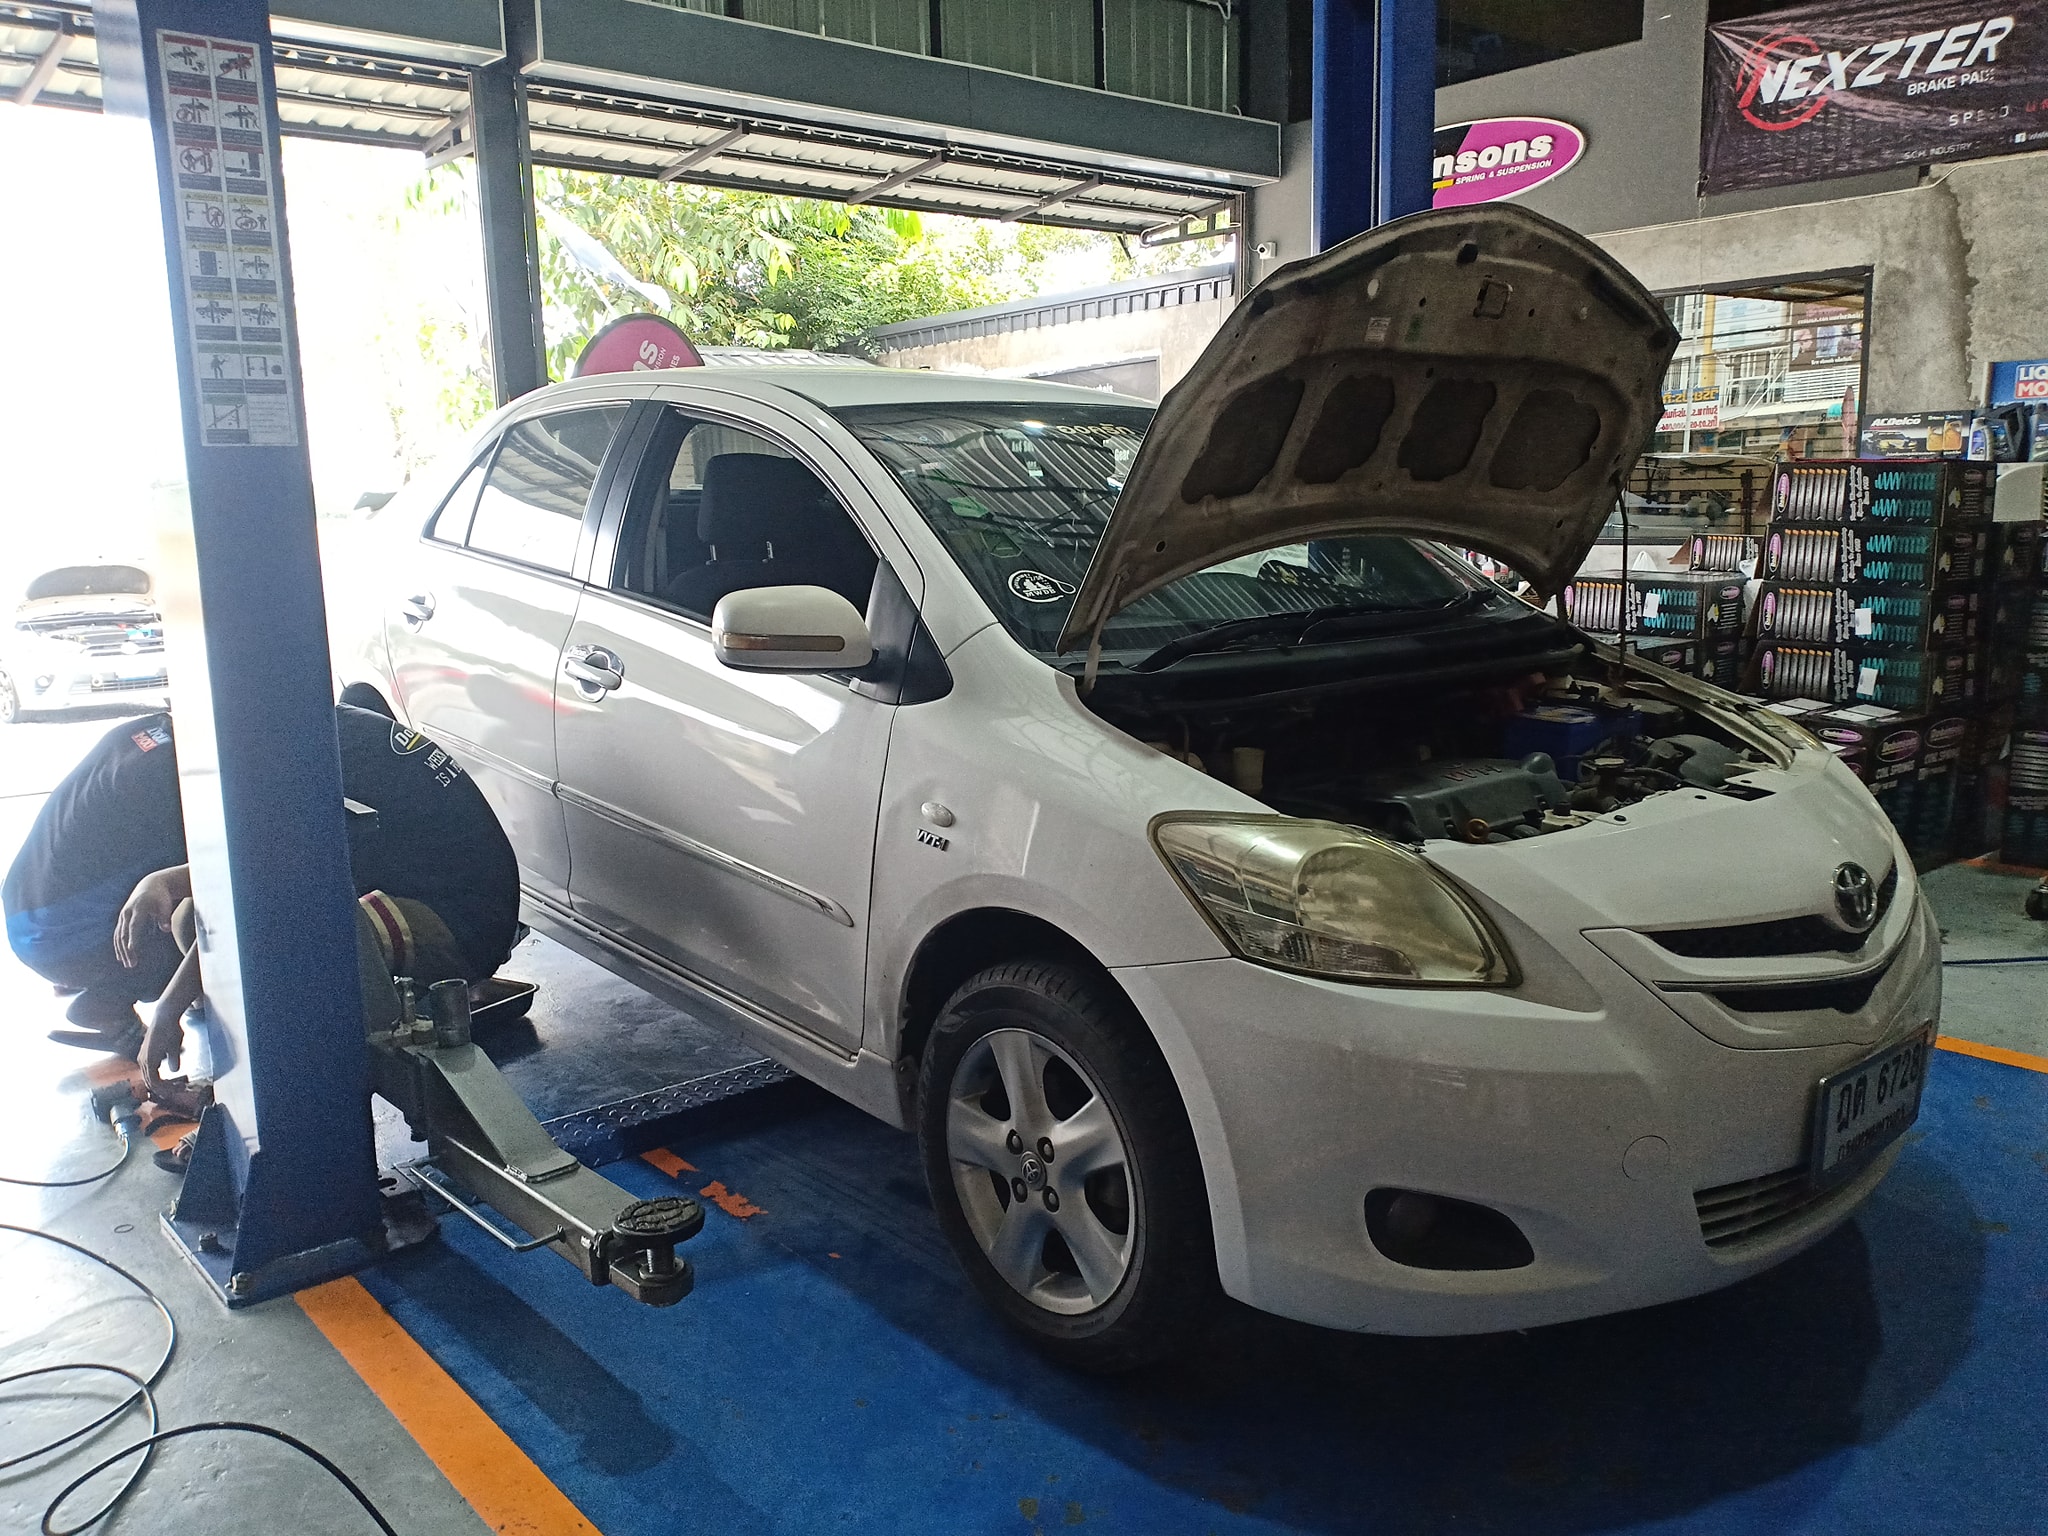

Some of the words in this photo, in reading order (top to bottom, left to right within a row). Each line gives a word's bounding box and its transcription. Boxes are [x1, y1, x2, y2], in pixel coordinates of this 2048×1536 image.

[1758, 16, 2016, 105] NEXZTER
[1907, 75, 1957, 96] BRAKE
[1433, 135, 1554, 179] nsons
[1455, 172, 1486, 185] SPRING
[1496, 159, 1553, 177] SUSPENSION
[2019, 365, 2048, 381] LIQ
[2018, 381, 2048, 397] MO
[1871, 416, 1922, 427] ACDelco
[394, 728, 416, 747] Do
